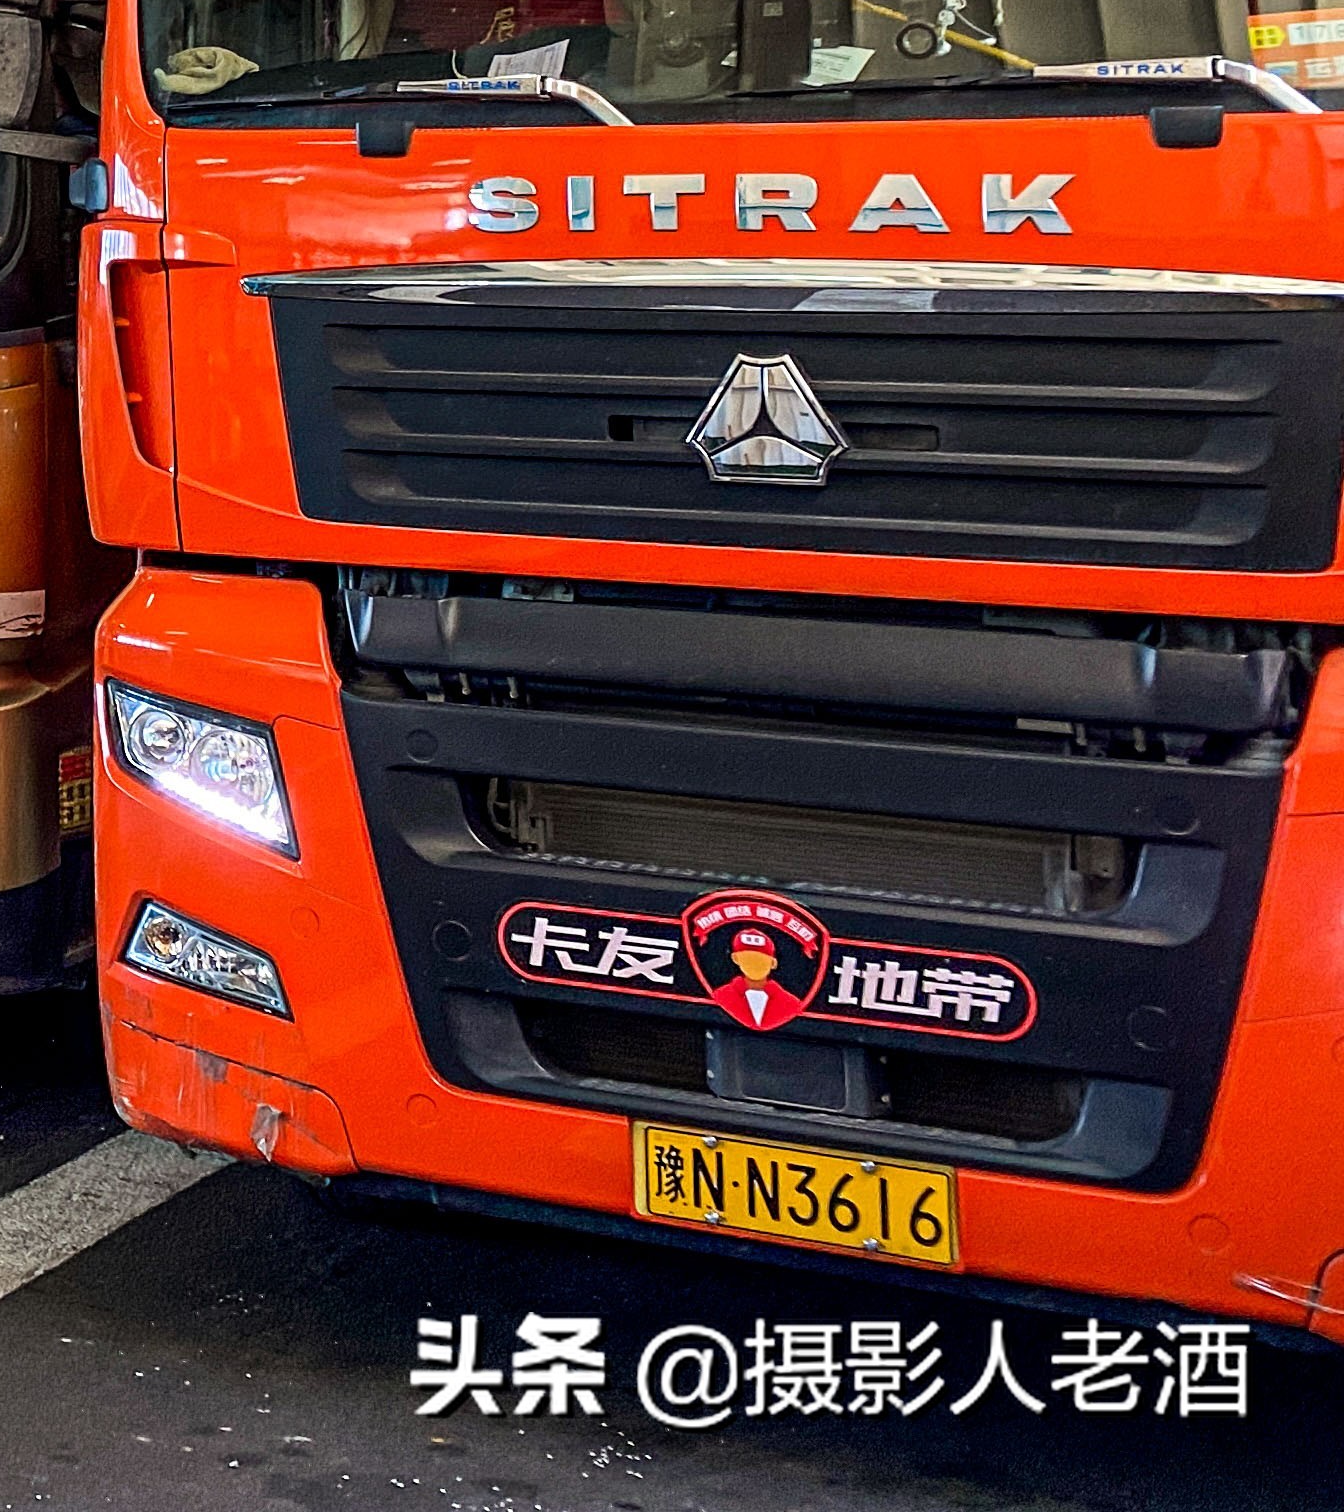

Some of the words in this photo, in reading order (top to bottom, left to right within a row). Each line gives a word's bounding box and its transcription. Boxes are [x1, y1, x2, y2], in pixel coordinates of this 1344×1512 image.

[447, 80, 521, 92] SITRAK
[1097, 64, 1184, 76] SITRAK
[468, 173, 1077, 234] SITRAK
[511, 917, 679, 985] 卡友
[828, 956, 1015, 1023] 地带
